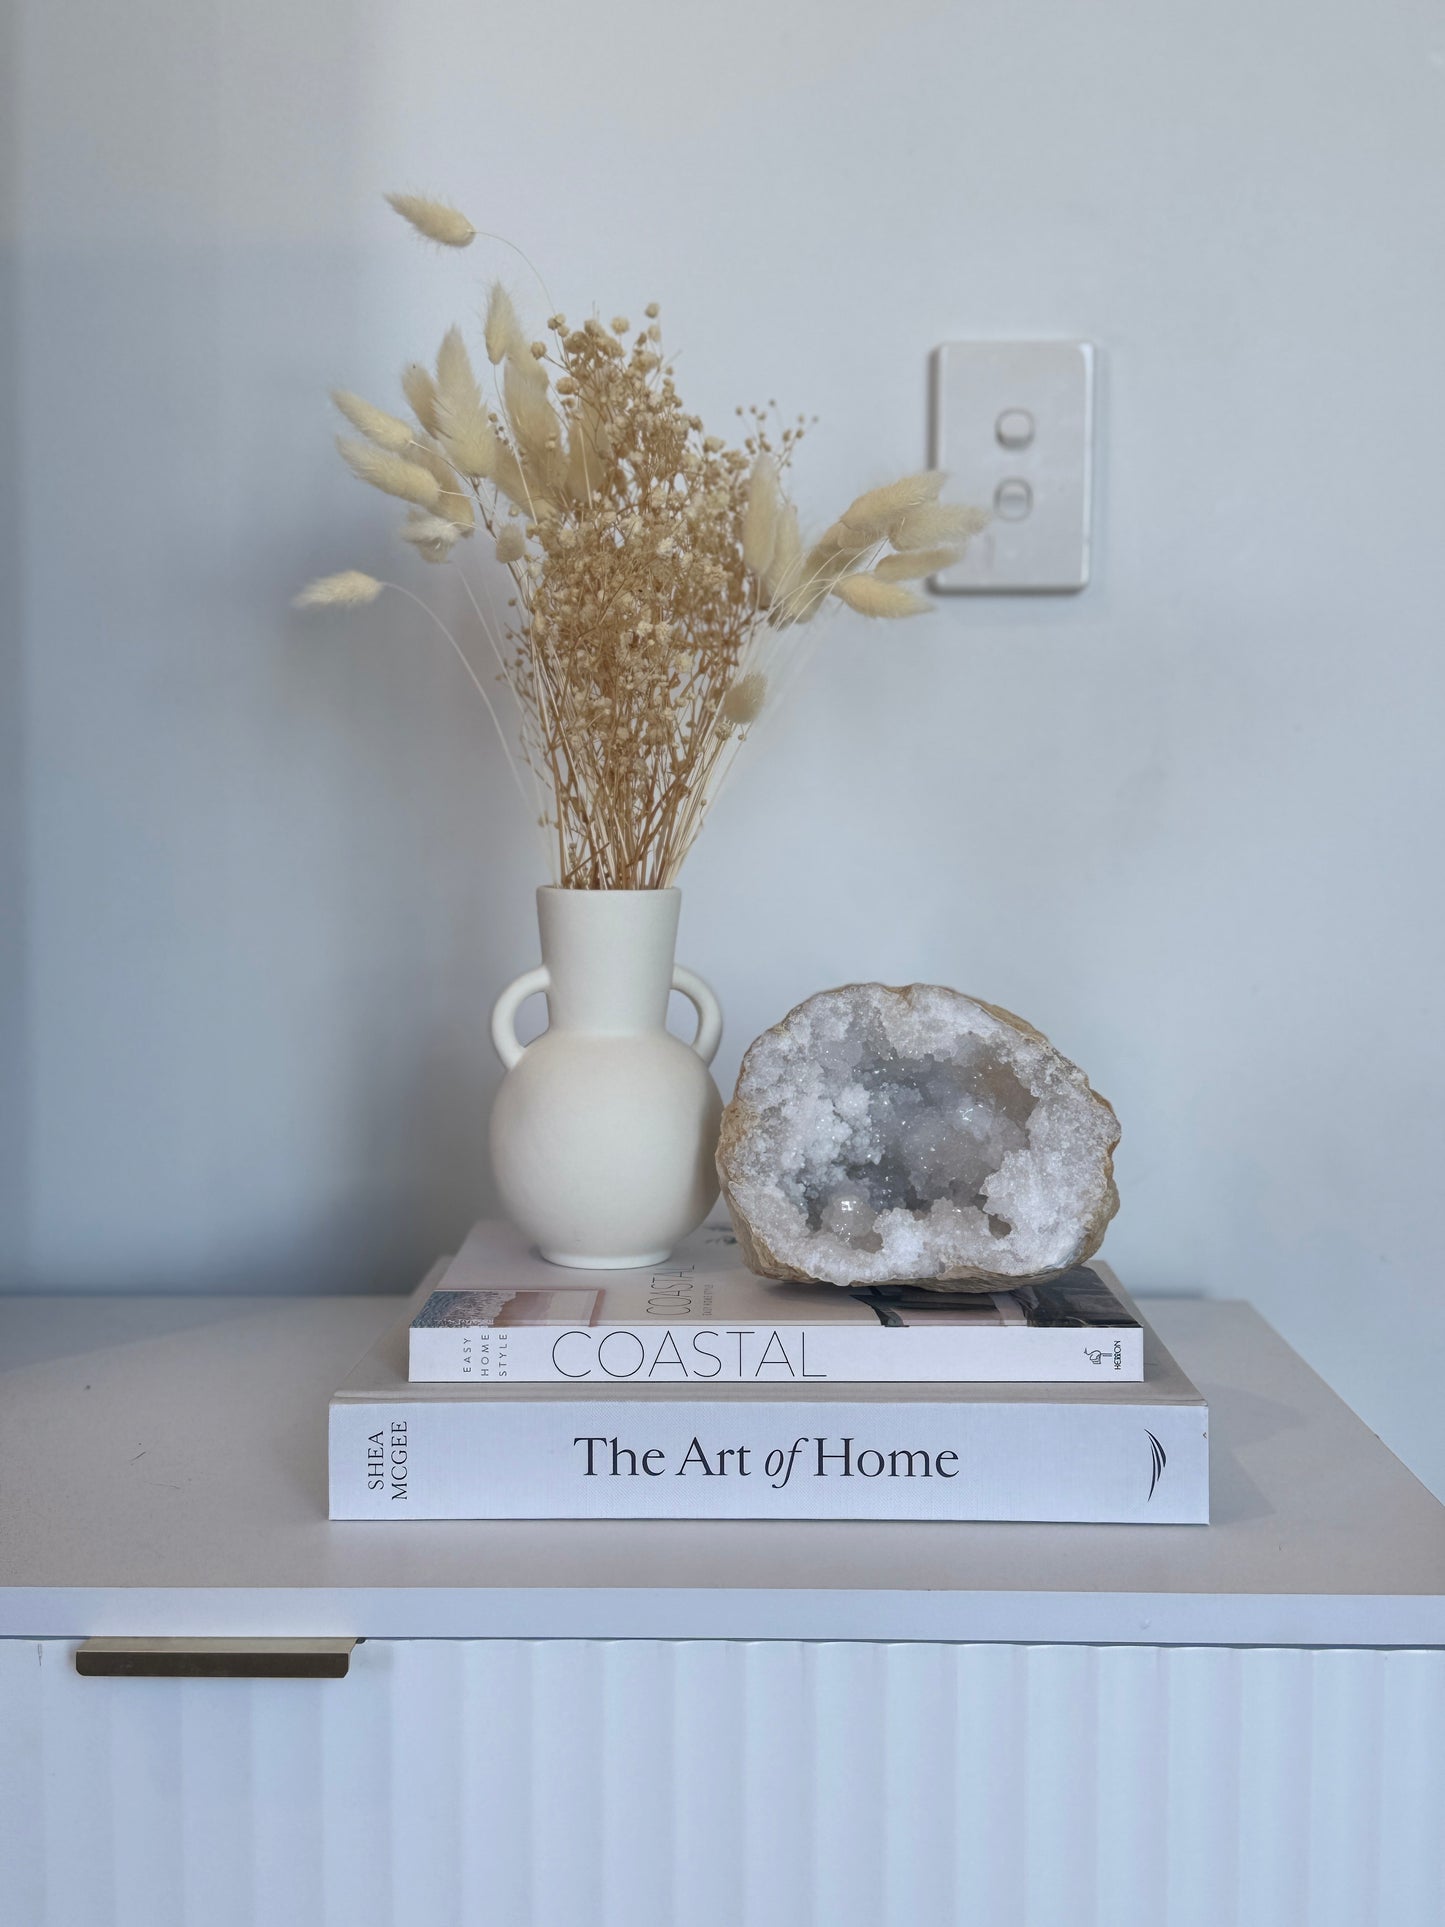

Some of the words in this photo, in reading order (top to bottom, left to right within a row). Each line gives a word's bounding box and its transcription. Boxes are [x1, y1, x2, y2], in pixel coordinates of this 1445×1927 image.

[645, 1264, 695, 1315] COASTAL
[463, 1337, 472, 1373] EASY
[481, 1334, 490, 1376] HOME
[498, 1334, 508, 1376] STYLE
[552, 1330, 828, 1378] COASTAL
[367, 1430, 385, 1490] SHEA
[391, 1421, 408, 1500] MCGEE
[573, 1436, 666, 1477] The
[674, 1436, 752, 1477] Art
[764, 1437, 810, 1489] of
[812, 1437, 960, 1478] Home
